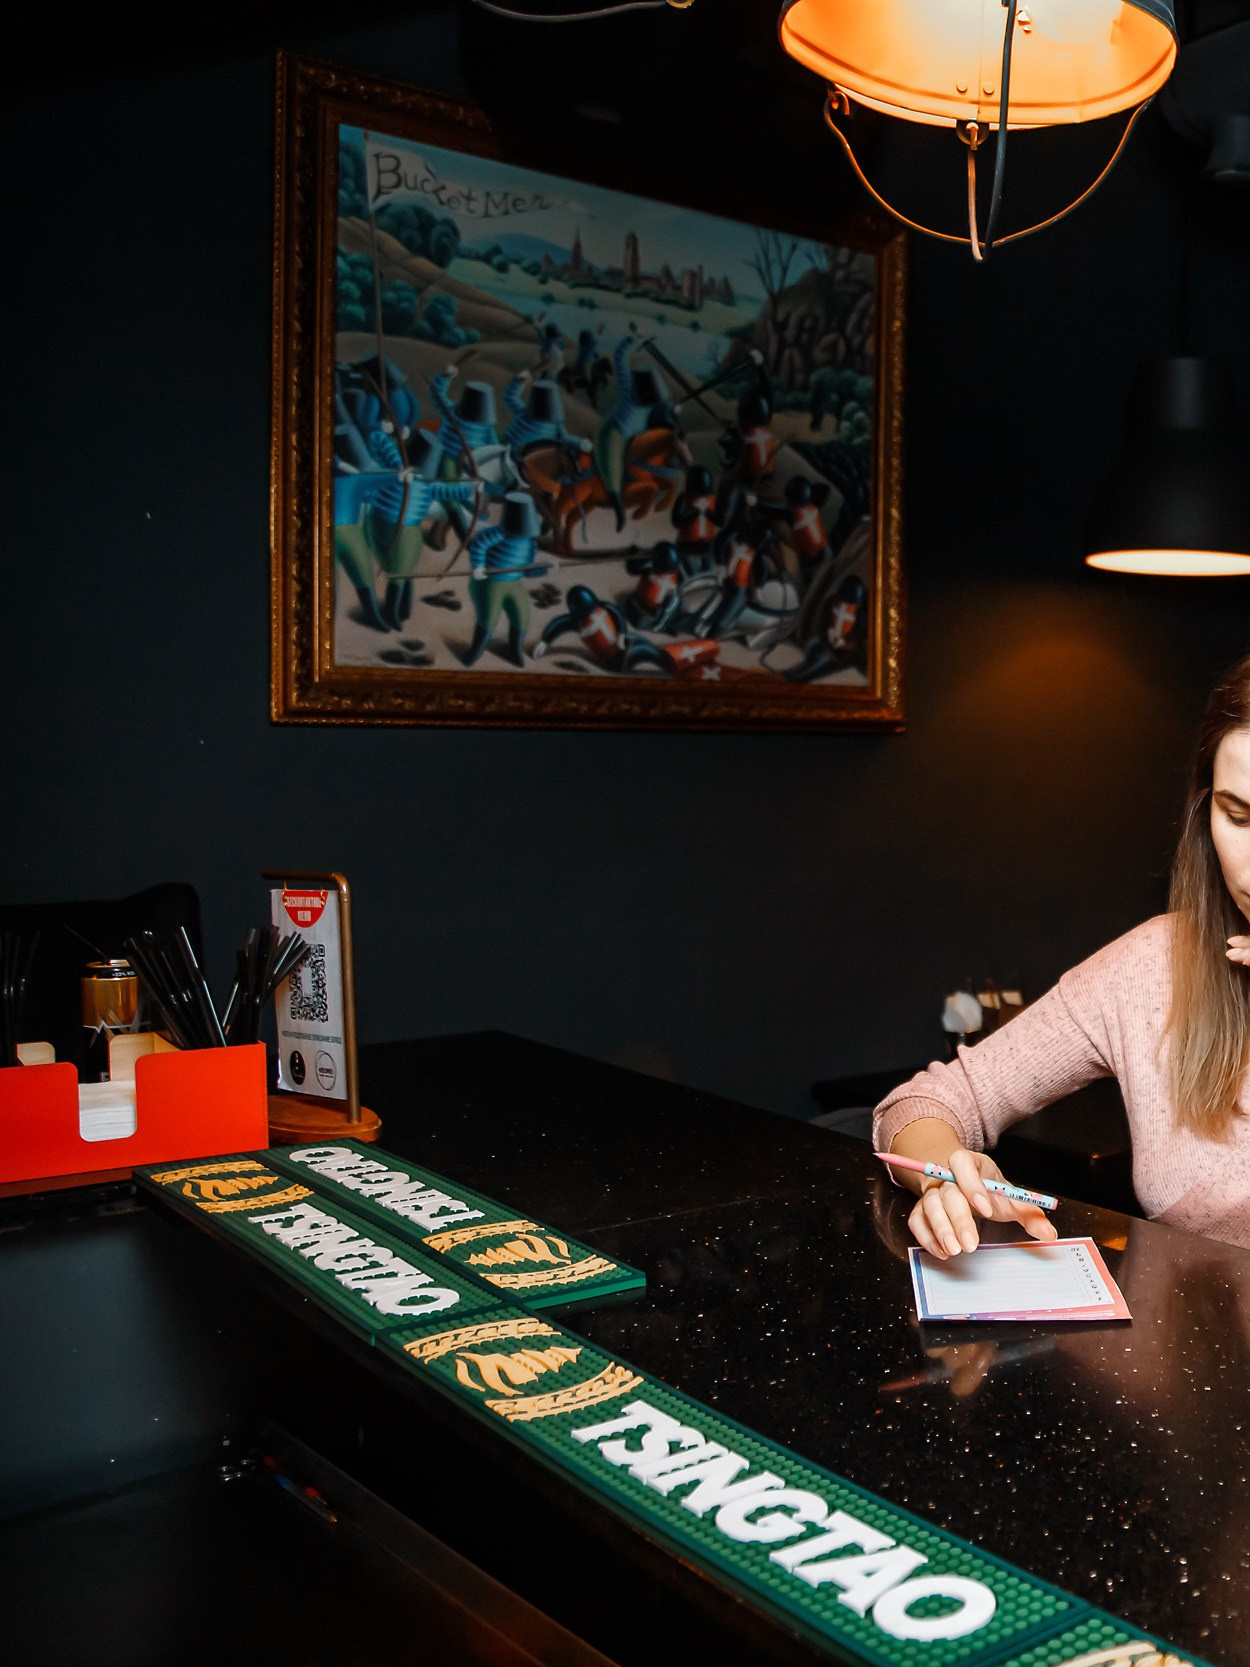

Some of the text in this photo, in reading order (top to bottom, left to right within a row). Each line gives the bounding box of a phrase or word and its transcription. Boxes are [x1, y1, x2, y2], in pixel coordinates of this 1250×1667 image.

[372, 152, 552, 218] Bucket Men
[289, 1146, 485, 1231] TSINGTAO
[248, 1203, 460, 1316] TSINGTAO
[570, 1401, 996, 1642] TSINGTAO
